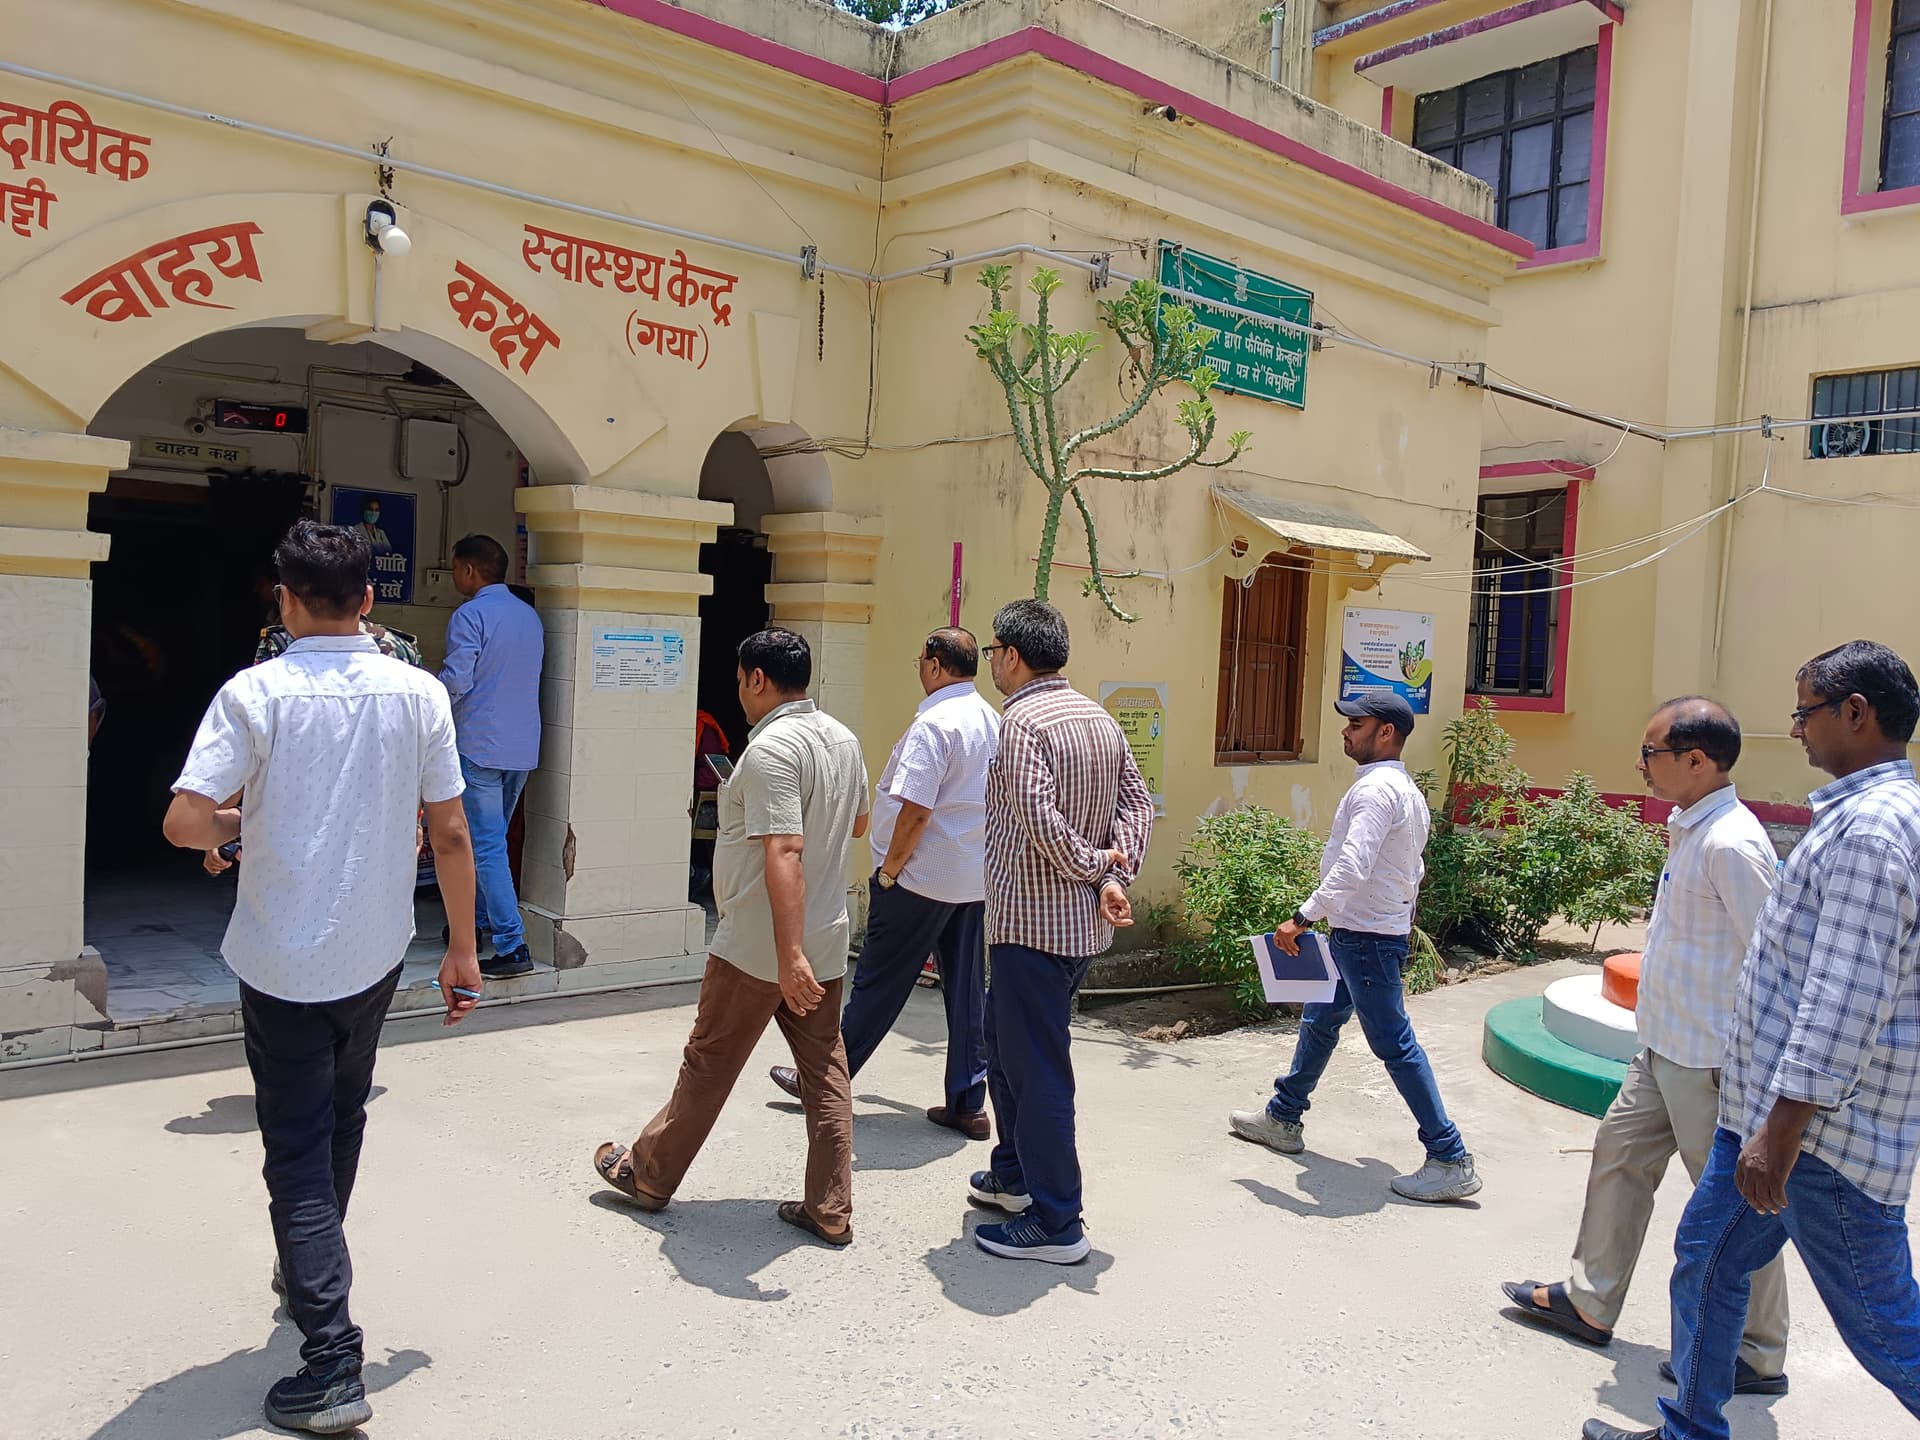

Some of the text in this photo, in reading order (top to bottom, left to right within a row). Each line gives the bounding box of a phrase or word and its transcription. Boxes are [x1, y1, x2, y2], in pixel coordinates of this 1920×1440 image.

[522, 223, 739, 326] स्वास्थ्य केन्द्र
[447, 259, 560, 375] कक्ष
[626, 308, 709, 370] (गया)
[1236, 363, 1250, 380] पत्र
[1252, 361, 1261, 383] से
[275, 412, 287, 429] 0
[208, 446, 240, 463] कक्ष
[375, 551, 407, 573] शांति
